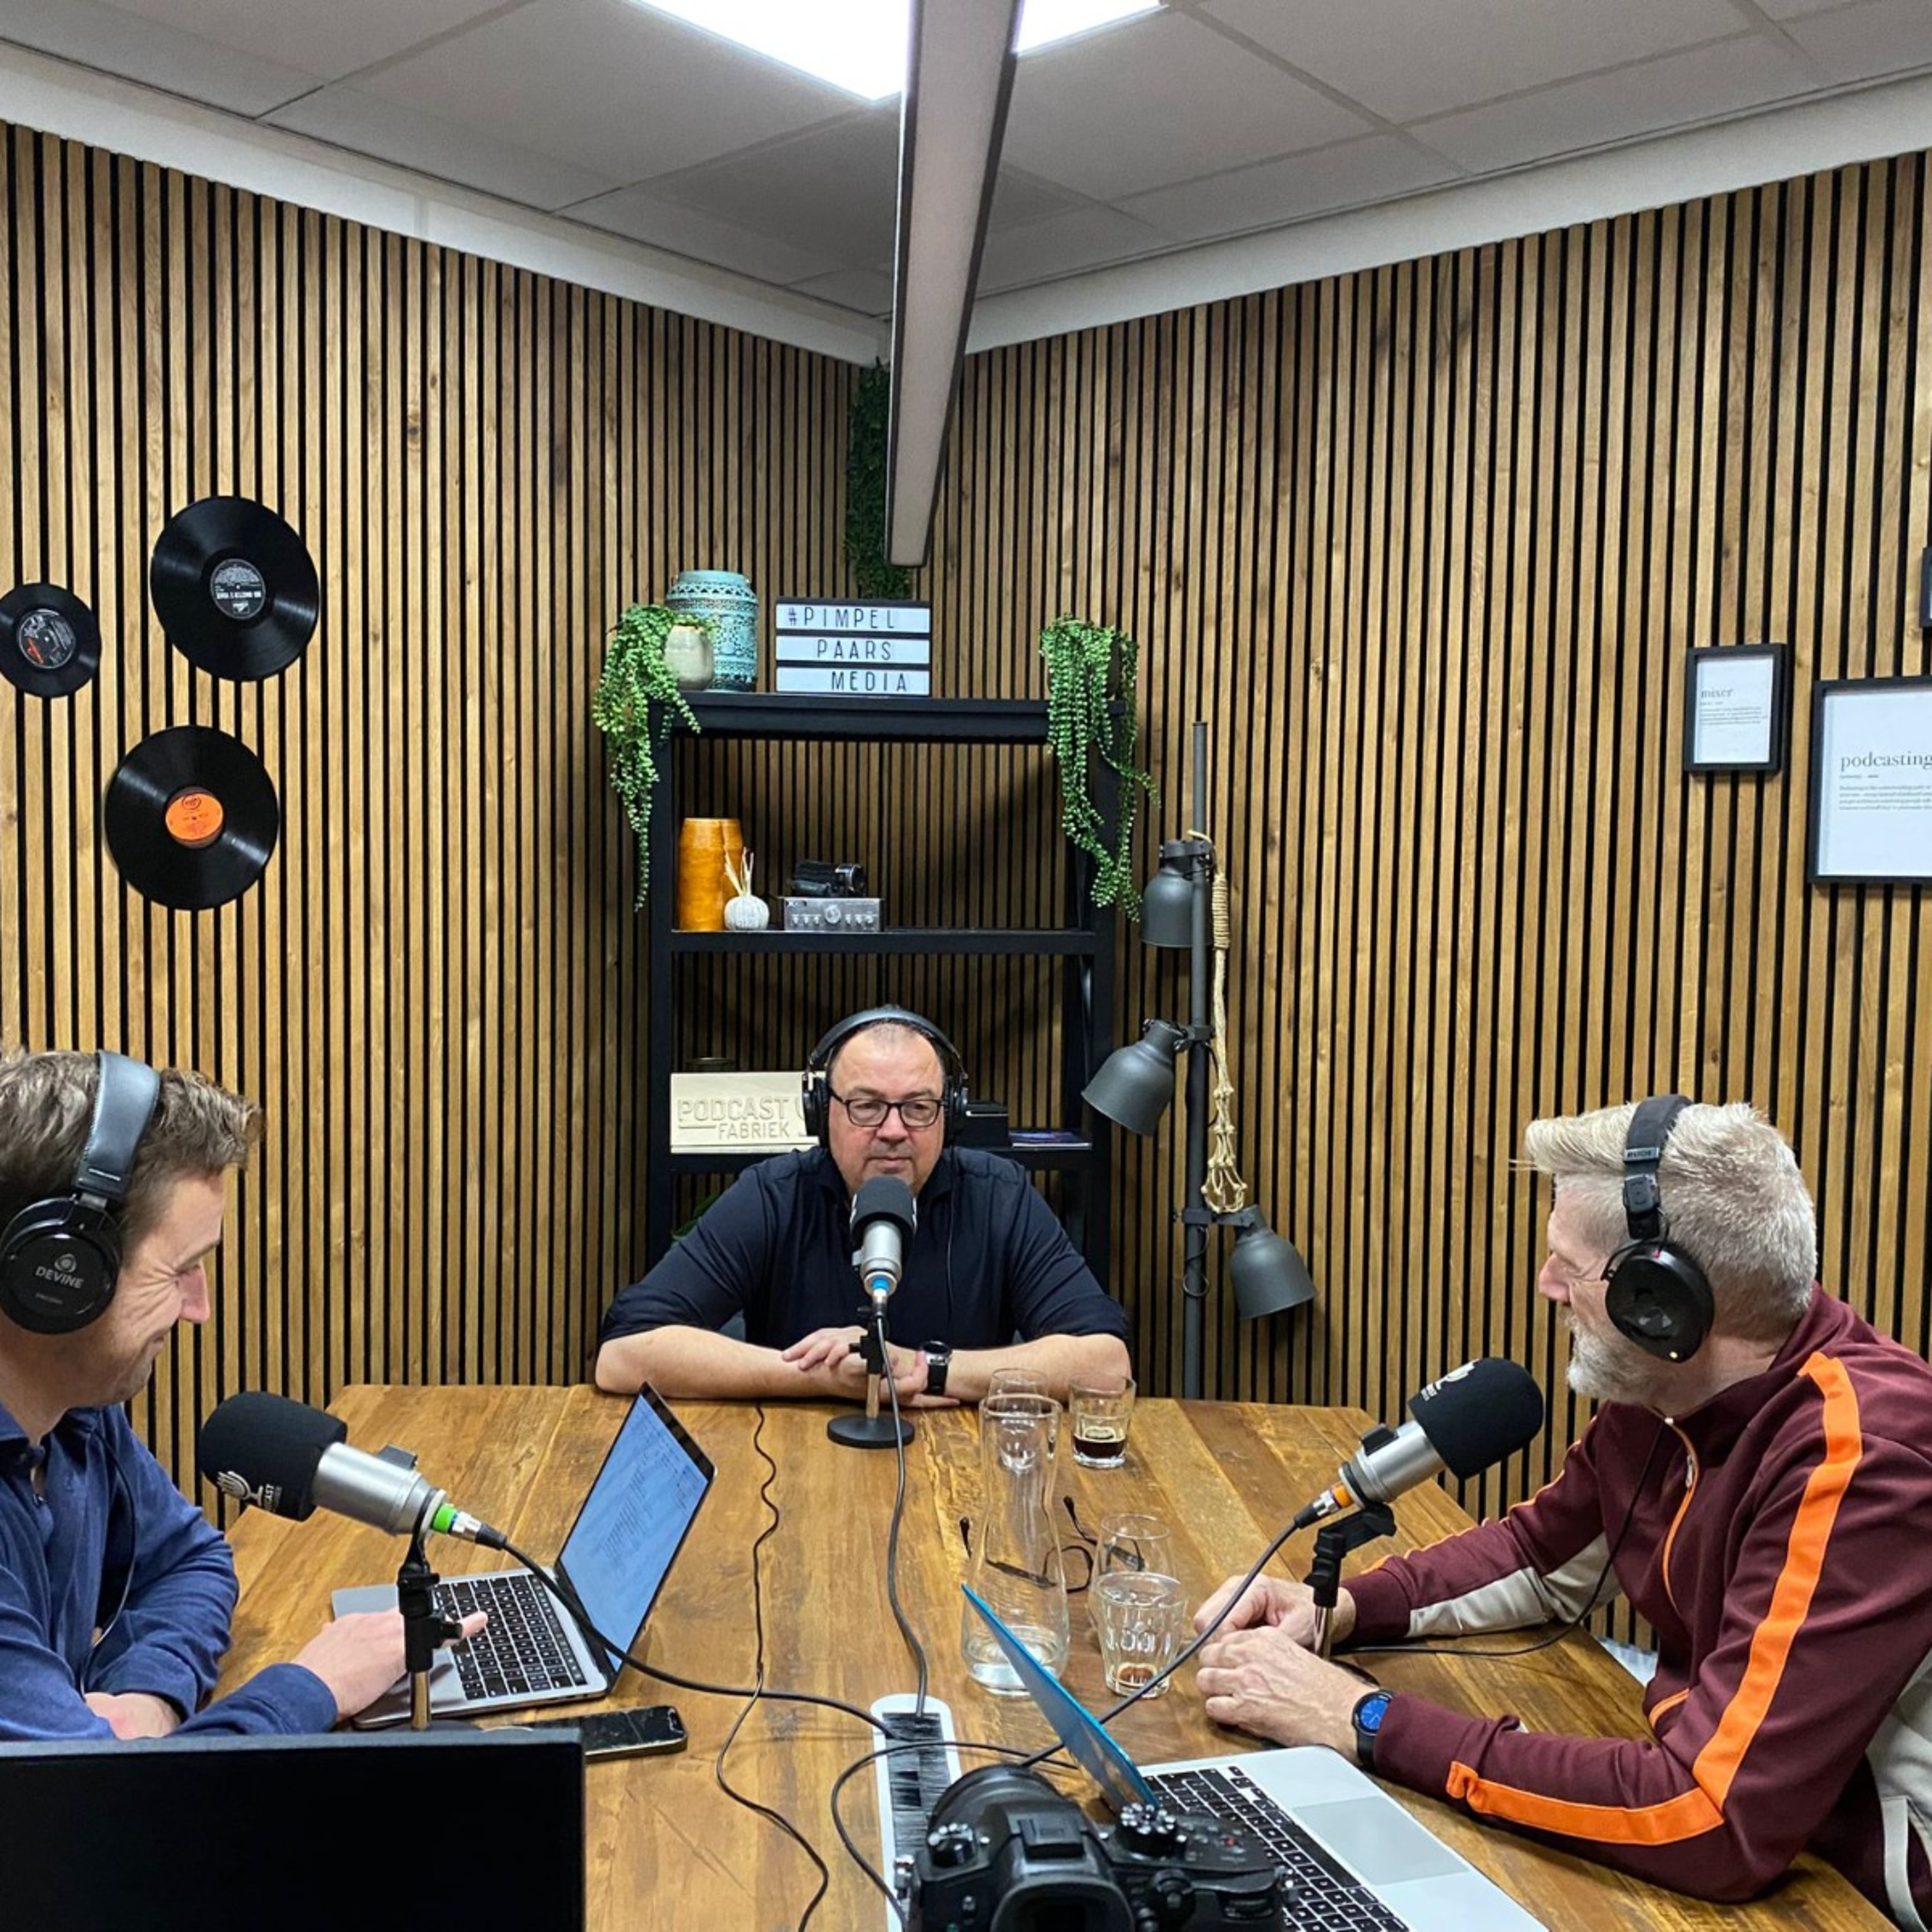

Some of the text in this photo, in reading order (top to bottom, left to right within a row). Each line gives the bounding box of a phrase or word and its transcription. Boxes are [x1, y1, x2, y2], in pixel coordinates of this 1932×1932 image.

[788, 607, 894, 629] #PIMPEL
[817, 639, 891, 660] PAARS
[831, 671, 907, 692] MEDIA
[1841, 750, 1932, 772] podcasting
[677, 1097, 789, 1122] PODCAST
[718, 1122, 790, 1140] FABRIEK
[35, 1266, 85, 1289] DEVINE
